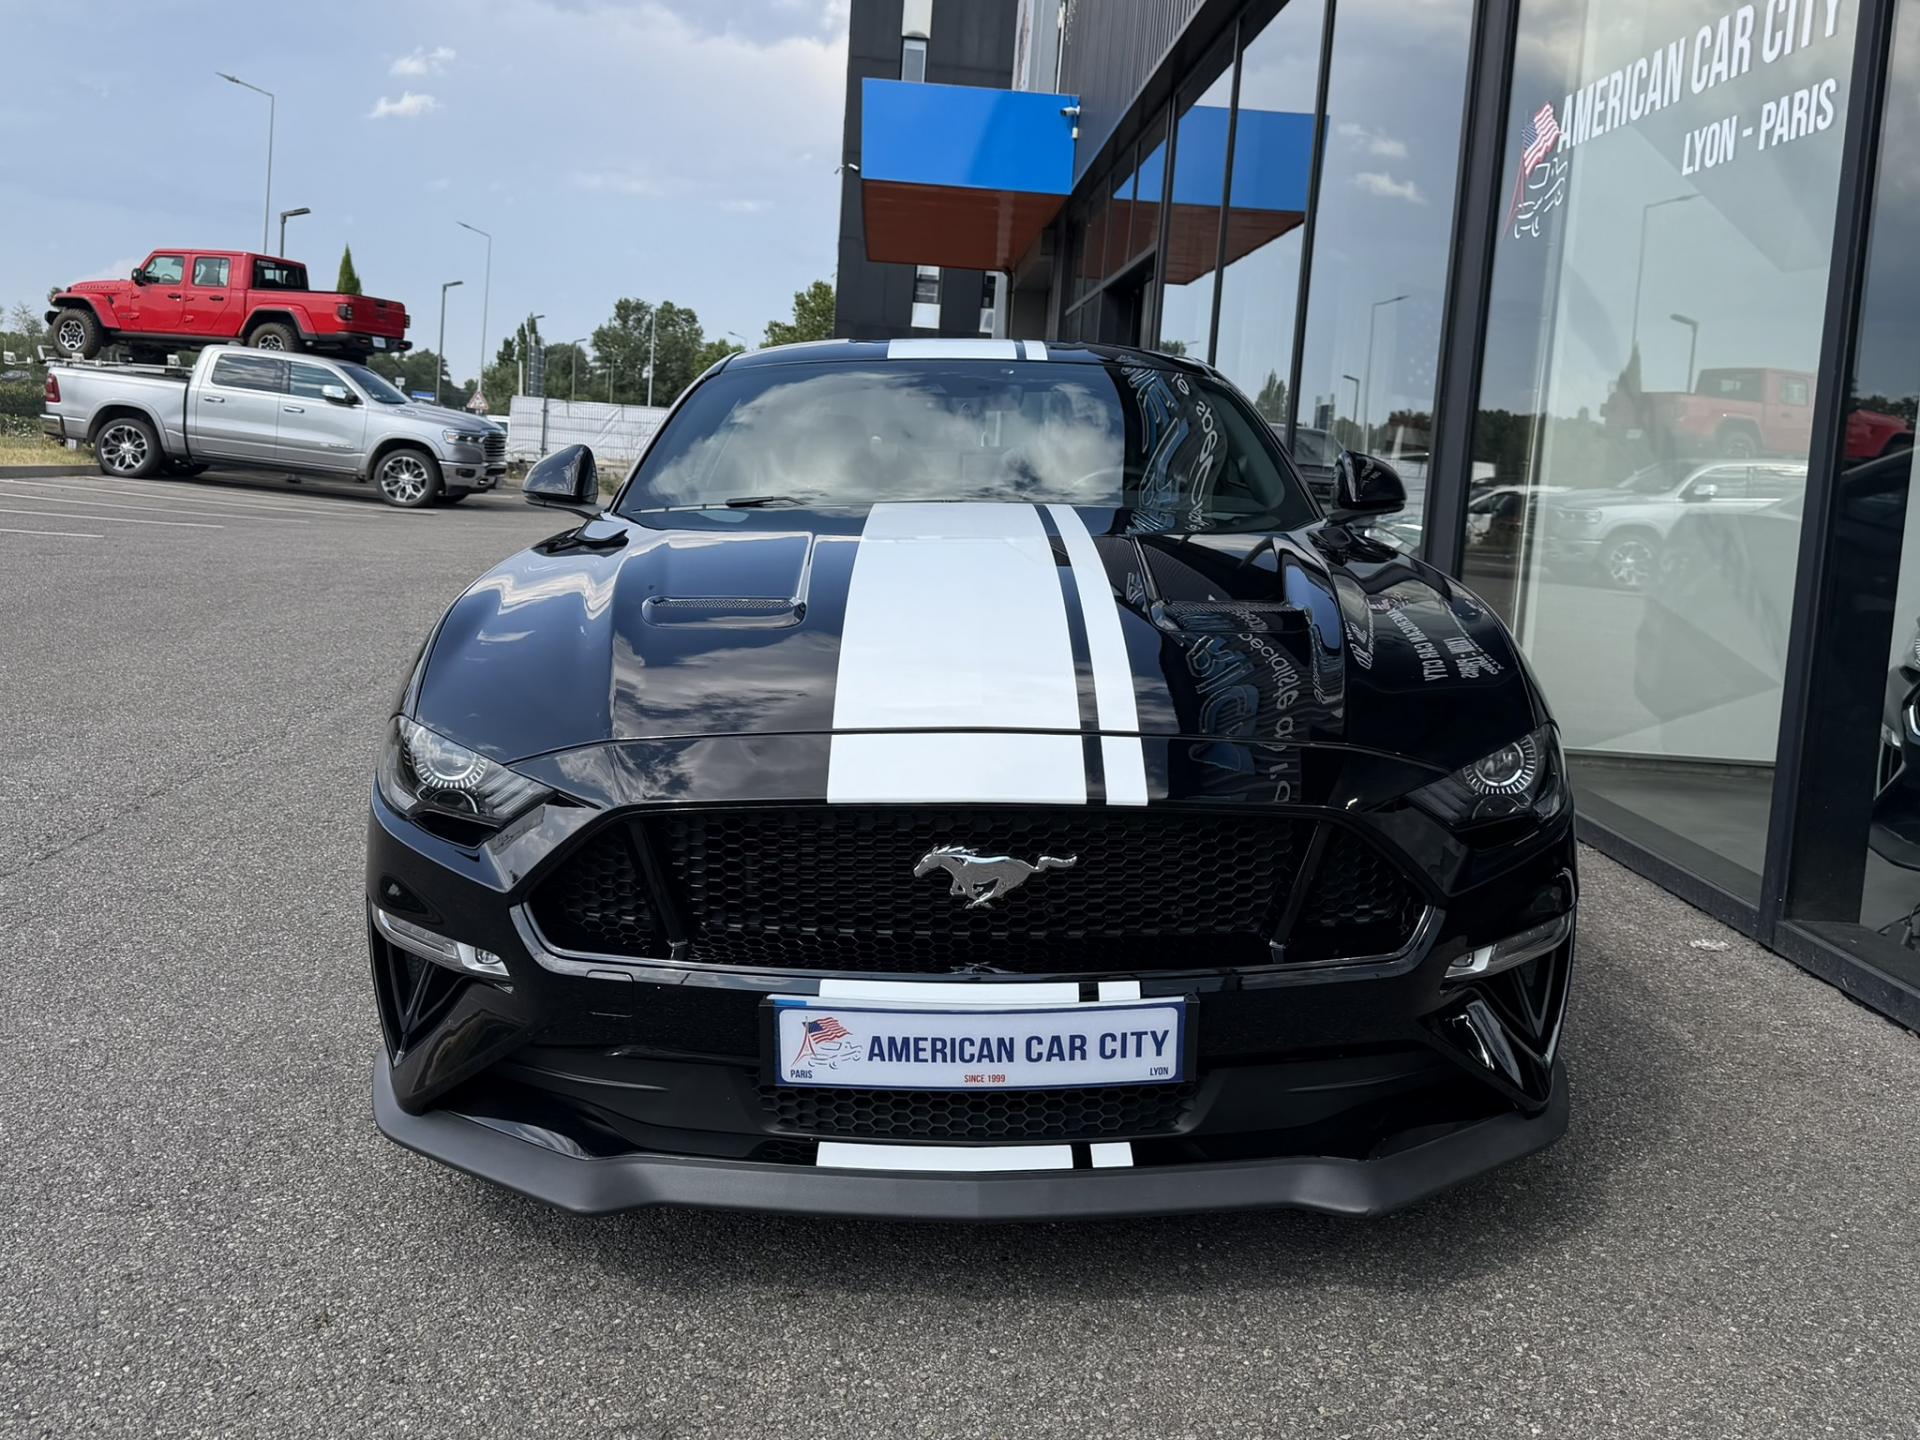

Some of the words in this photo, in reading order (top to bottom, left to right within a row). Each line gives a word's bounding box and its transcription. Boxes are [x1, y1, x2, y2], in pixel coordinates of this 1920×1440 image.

[1557, 37, 1686, 153] AMERICAN
[1691, 4, 1755, 94] CAR
[1682, 115, 1738, 176] LYON
[1758, 78, 1837, 151] PARIS
[867, 1036, 1015, 1063] AMERICAN
[1025, 1034, 1087, 1062] CAR
[1099, 1030, 1170, 1060] CITY
[790, 1069, 813, 1079] PARIS
[964, 1074, 985, 1083] SINCE
[987, 1074, 1006, 1083] 1999
[1150, 1066, 1169, 1076] LYON
